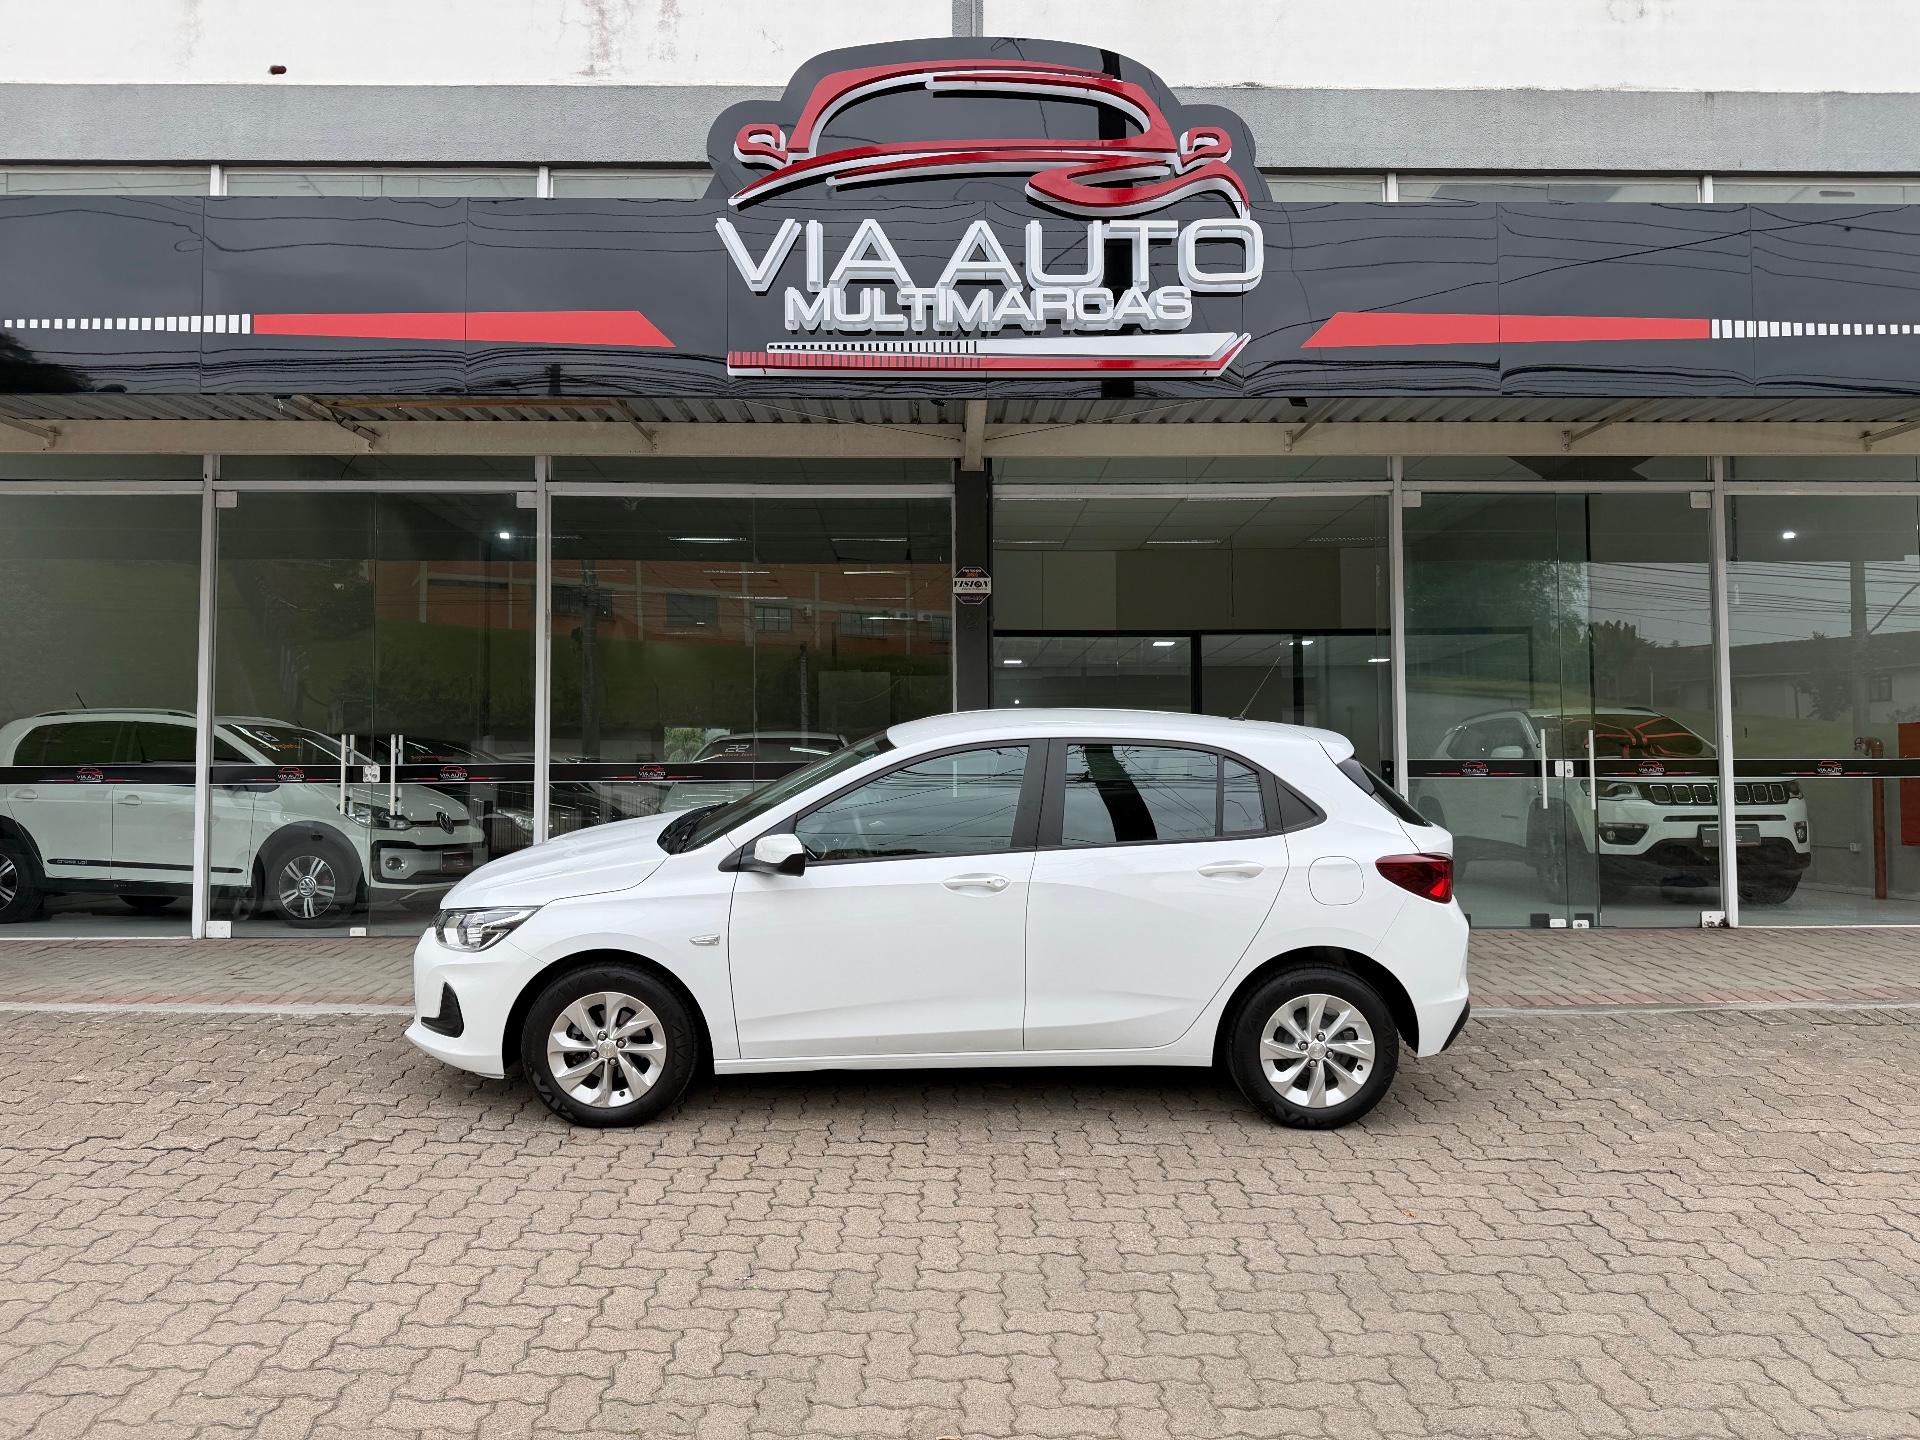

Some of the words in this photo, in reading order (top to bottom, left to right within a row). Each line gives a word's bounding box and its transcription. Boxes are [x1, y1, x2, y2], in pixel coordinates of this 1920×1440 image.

[715, 218, 914, 292] VIA
[935, 218, 1264, 292] AUTO
[785, 286, 1193, 331] MULTIMARCAS
